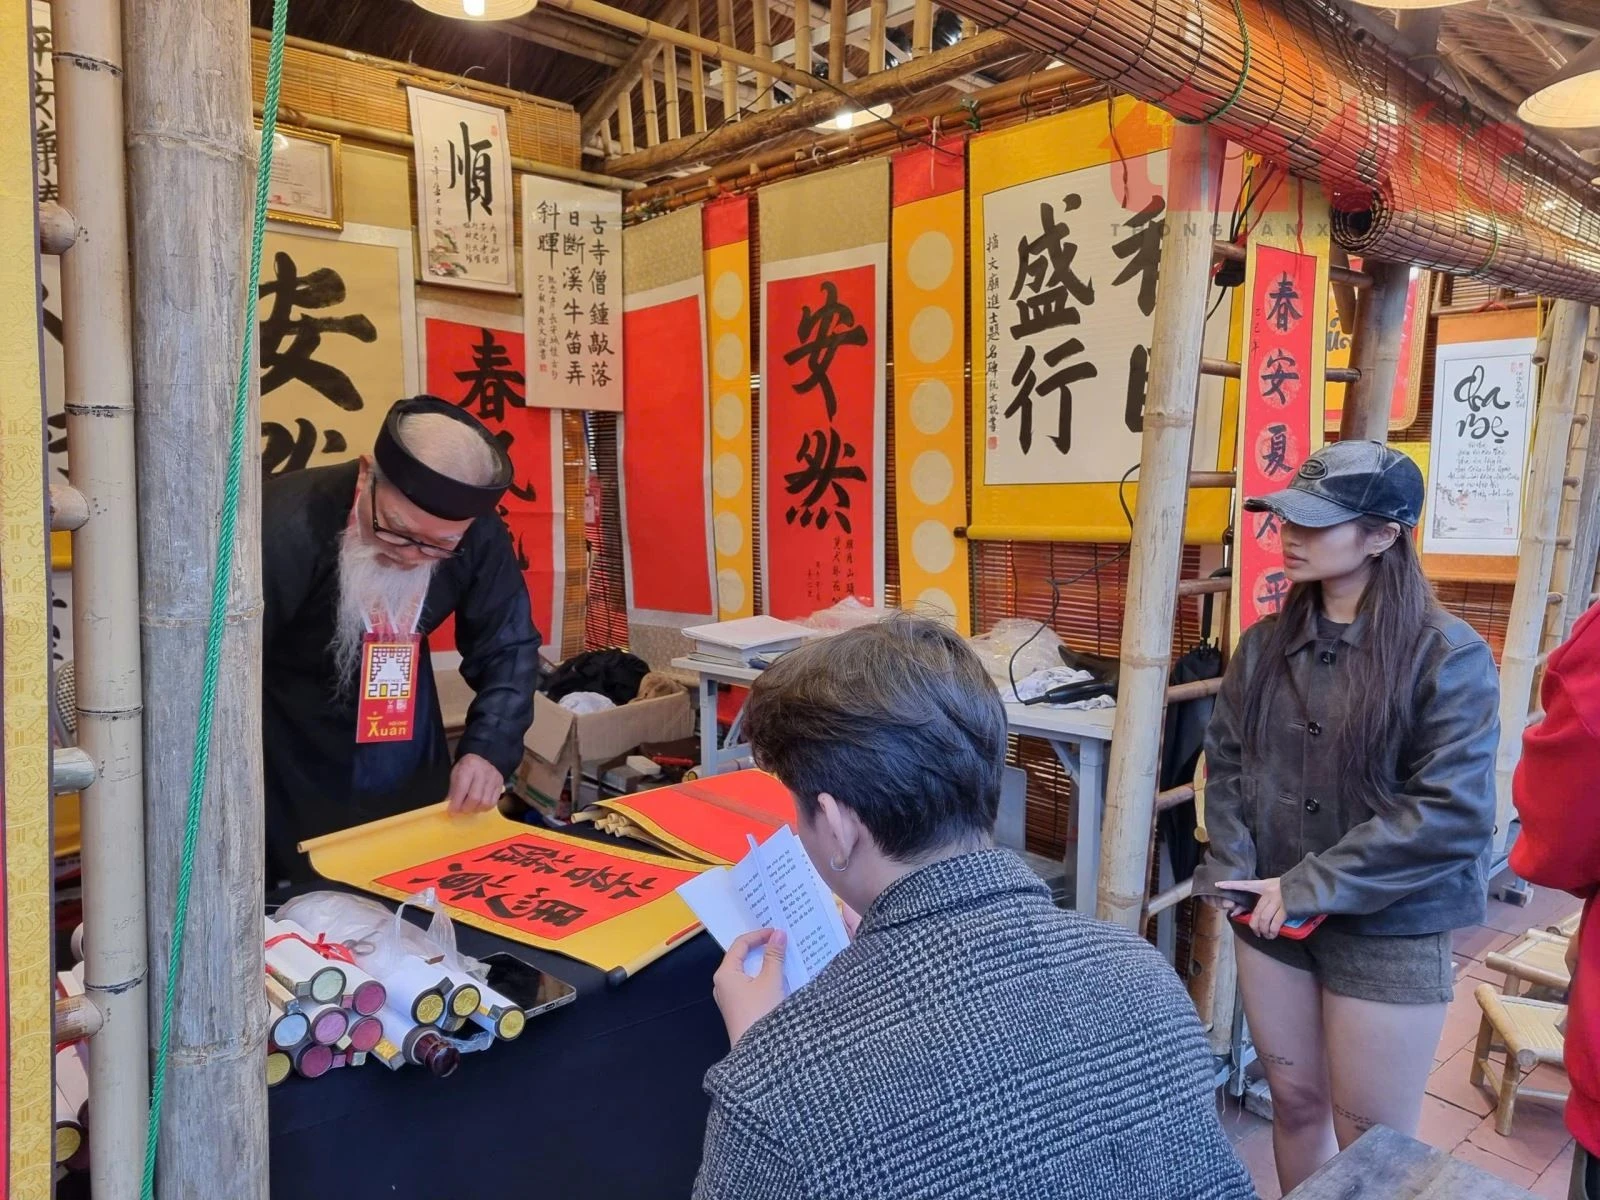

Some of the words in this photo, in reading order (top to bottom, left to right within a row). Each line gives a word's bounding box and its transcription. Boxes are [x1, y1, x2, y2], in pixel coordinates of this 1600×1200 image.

[447, 120, 493, 222] 順
[782, 279, 868, 535] 安然
[1003, 192, 1099, 456] 盛行
[367, 682, 411, 698] 2026
